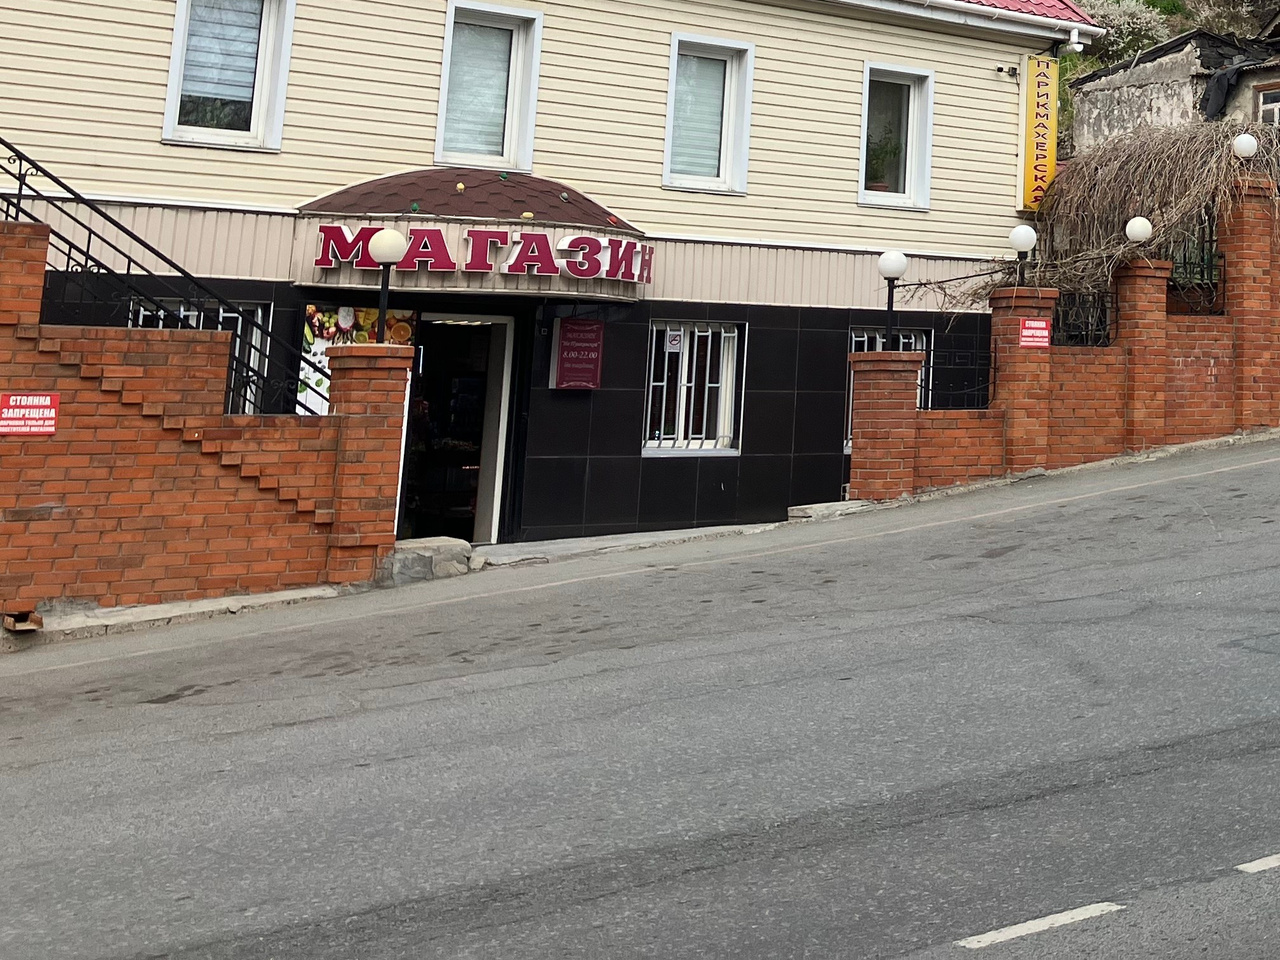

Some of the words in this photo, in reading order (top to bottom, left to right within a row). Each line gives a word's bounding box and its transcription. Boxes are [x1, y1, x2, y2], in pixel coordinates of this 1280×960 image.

[1030, 59, 1051, 205] ПАРИКМАХЕРСКАЯ
[313, 224, 655, 285] МАГАЗИН
[1, 408, 56, 419] ЗАПРЕЩЕНА
[9, 395, 51, 406] СТОЯНКА
